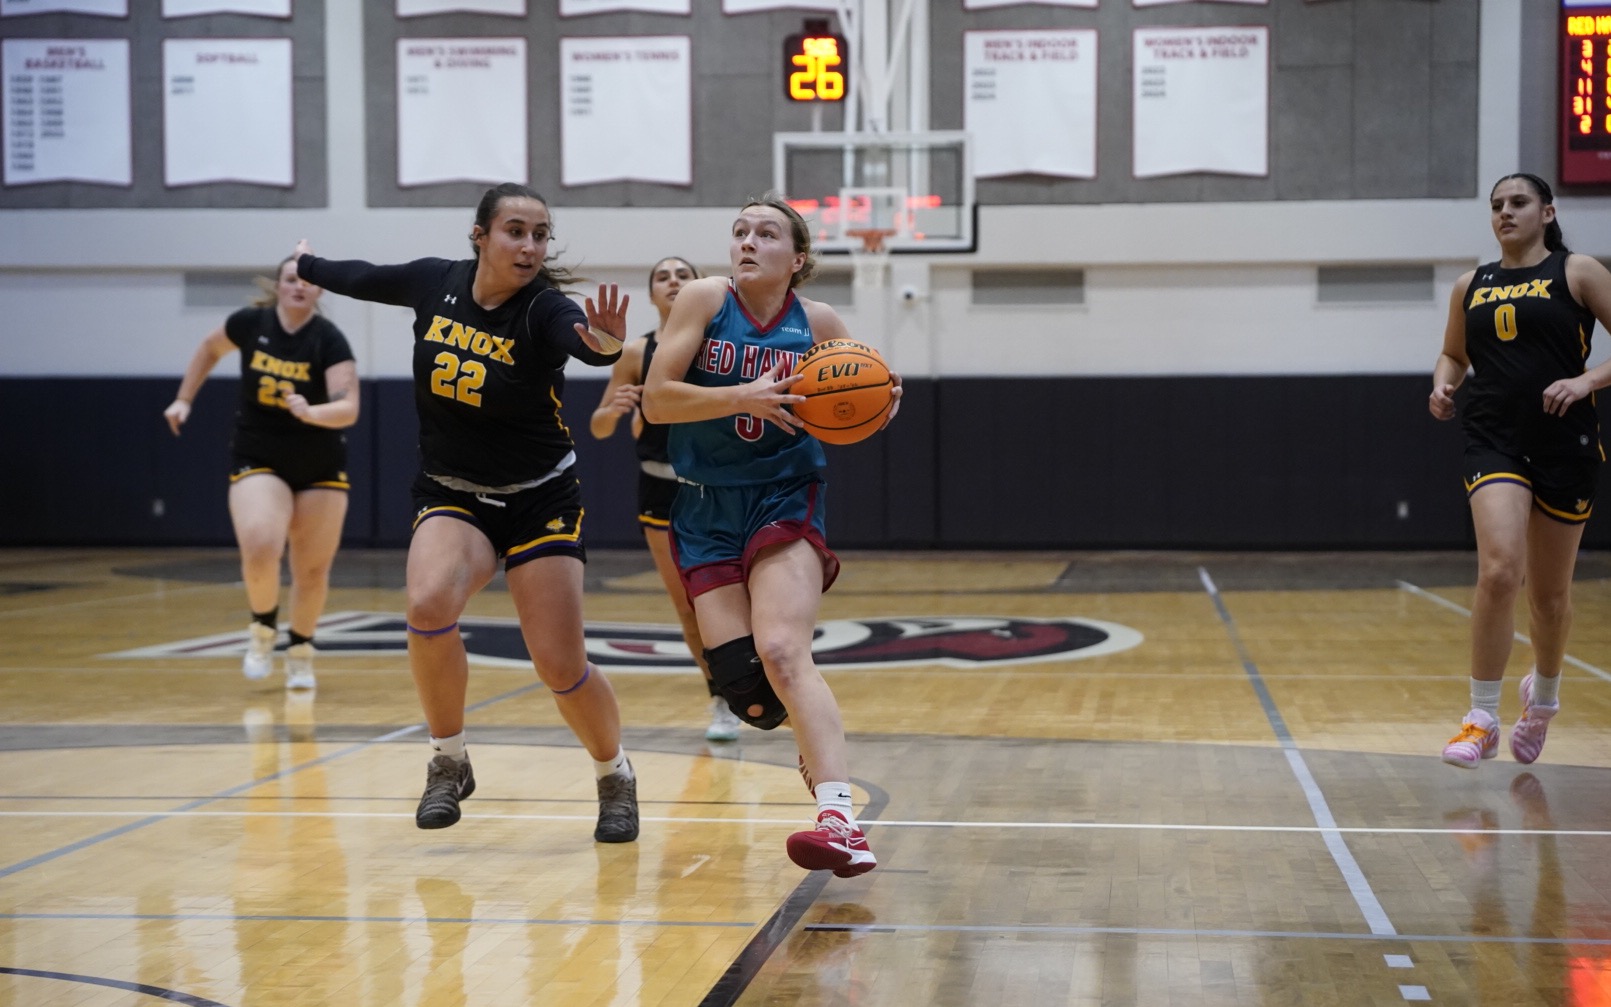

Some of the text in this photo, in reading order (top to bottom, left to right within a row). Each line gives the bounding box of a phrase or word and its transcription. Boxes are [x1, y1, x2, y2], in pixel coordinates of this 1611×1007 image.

[1567, 16, 1595, 36] RED
[1582, 39, 1593, 58] 3
[790, 54, 844, 100] 26
[1469, 279, 1552, 310] KNOX
[1494, 303, 1518, 341] 0
[424, 315, 515, 366] KNOX
[802, 340, 871, 363] Wilson
[250, 349, 312, 382] KNOX
[431, 351, 487, 407] 22
[741, 344, 805, 382] HAW
[817, 363, 860, 382] EVO
